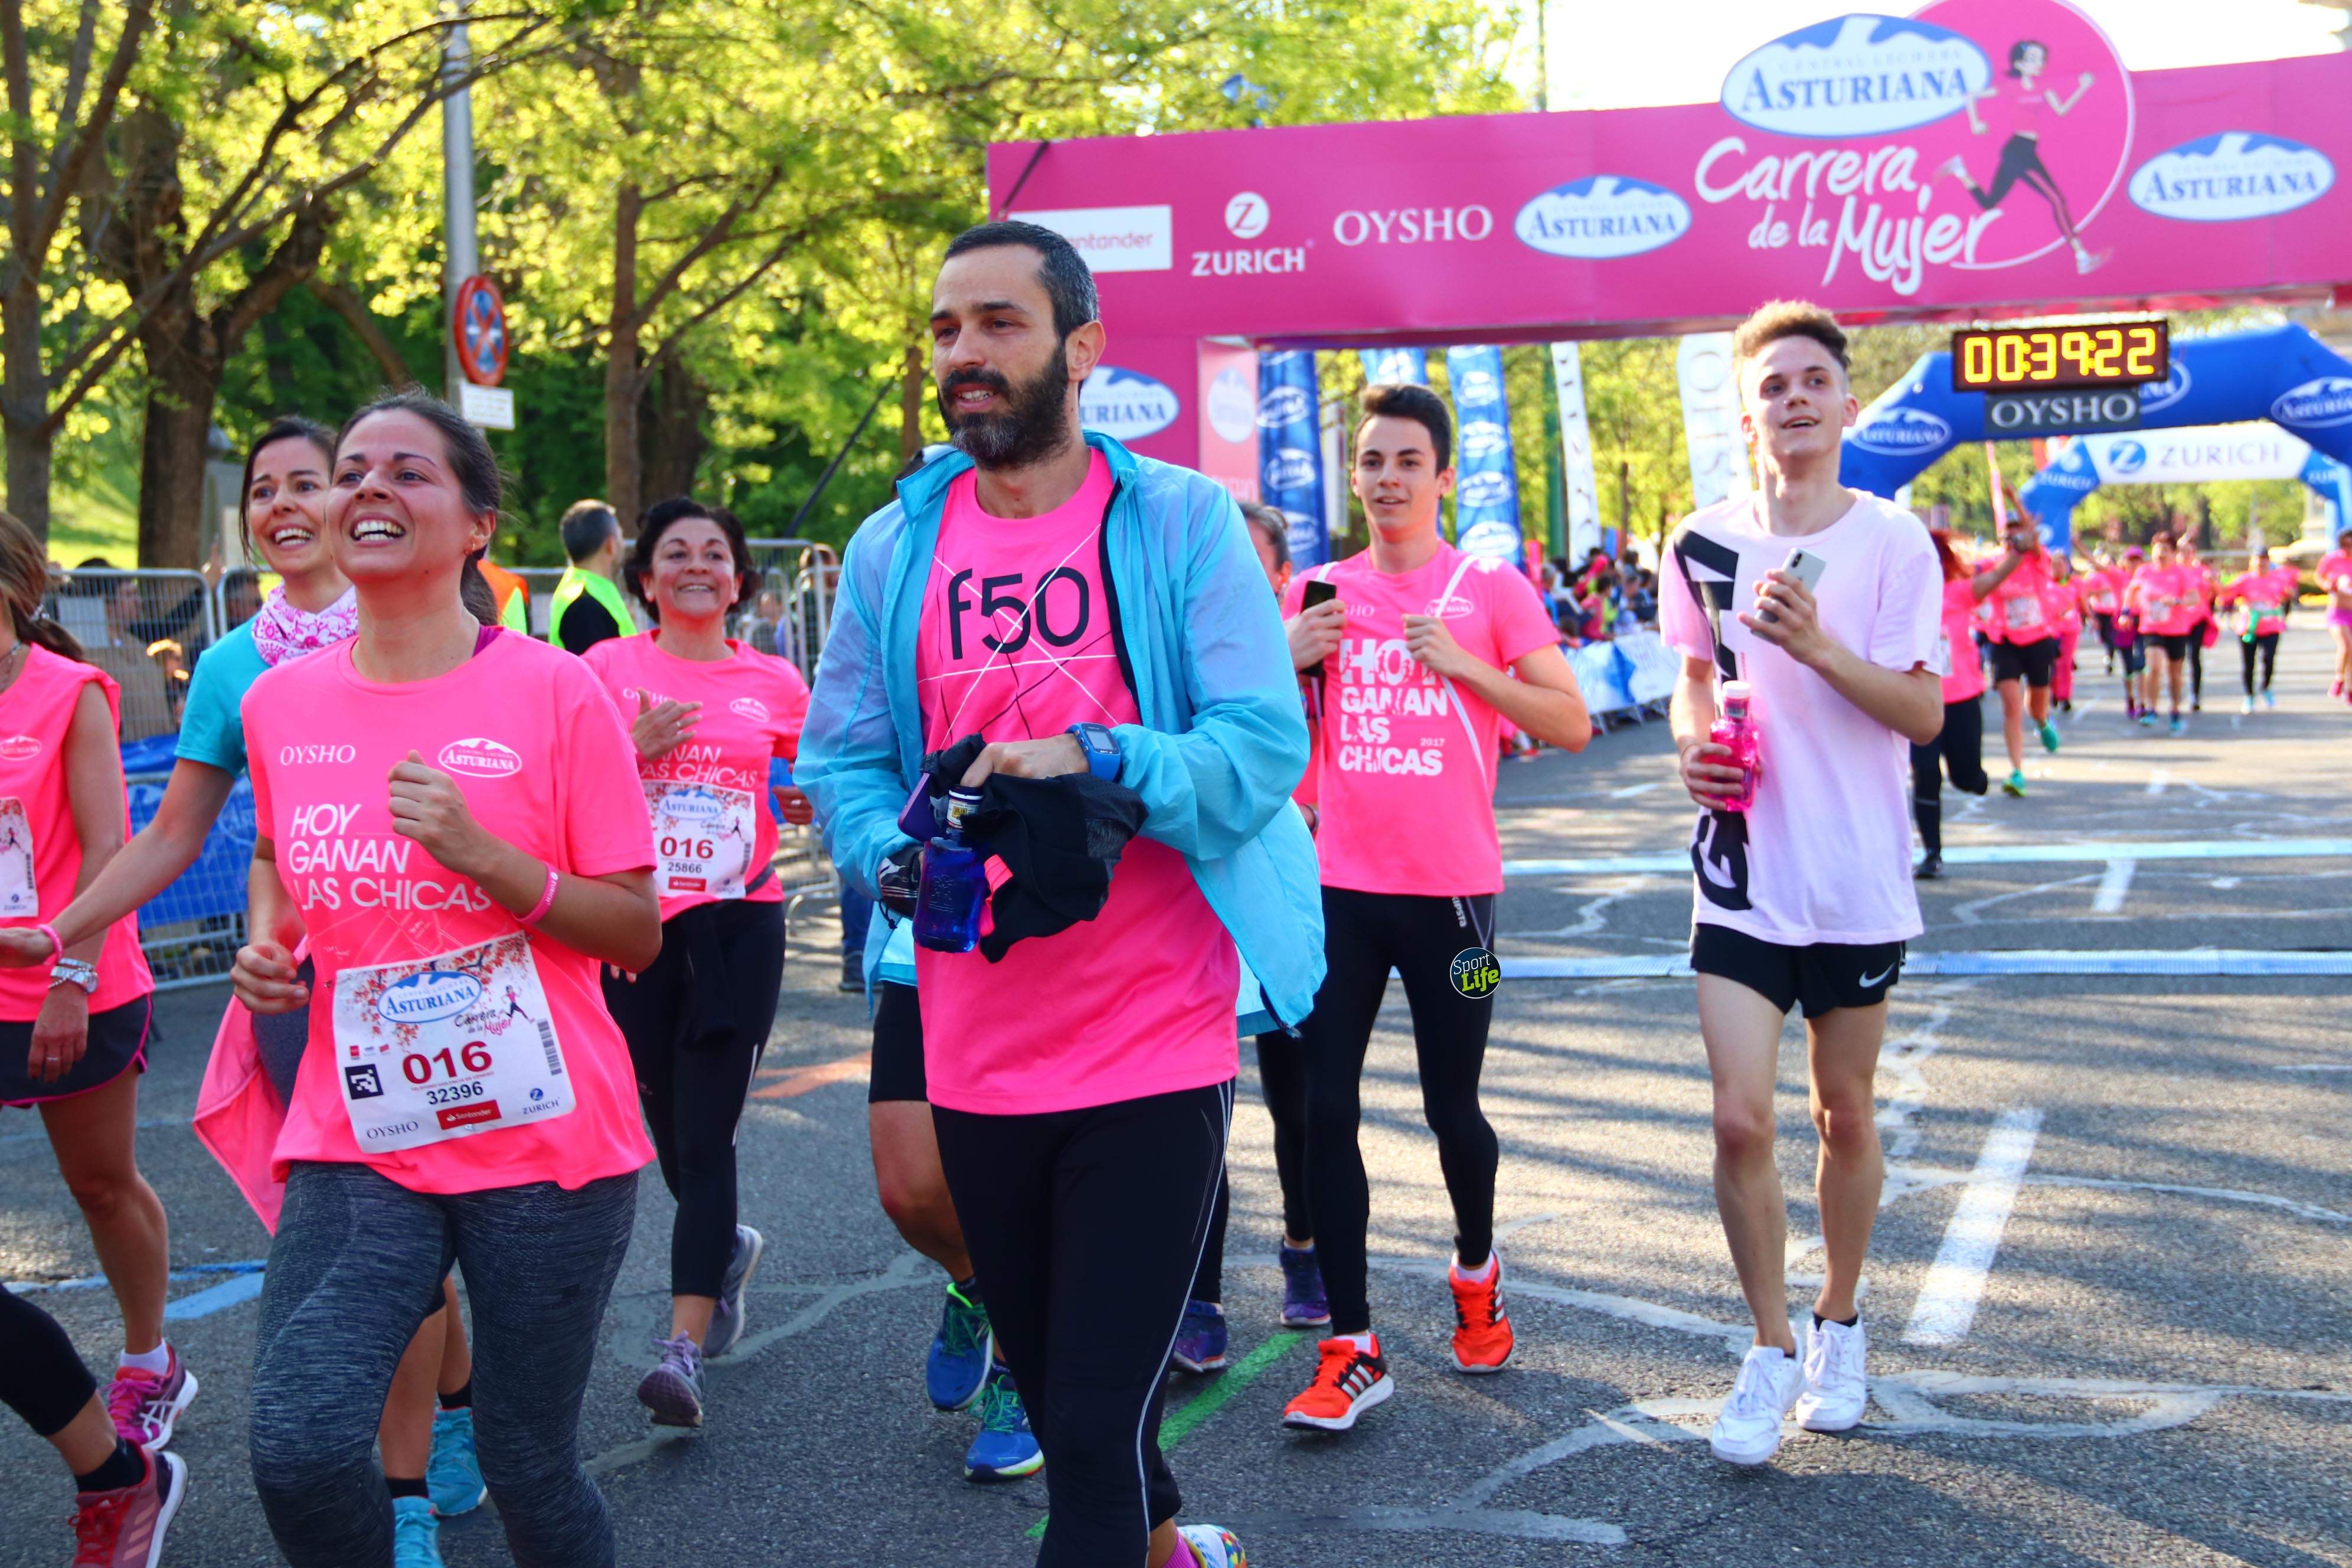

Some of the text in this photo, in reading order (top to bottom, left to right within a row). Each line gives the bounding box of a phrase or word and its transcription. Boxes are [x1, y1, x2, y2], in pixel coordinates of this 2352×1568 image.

[1740, 66, 1971, 112] ASTURIANA
[1695, 136, 1919, 204] Carrera
[2143, 170, 2318, 203] ASTURIANA
[1333, 204, 1493, 246] OYSHO
[1528, 210, 1677, 239] ASTURIANA
[1748, 184, 2004, 296] de la Mujer
[1191, 247, 1305, 276] ZURICH
[1964, 326, 2156, 384] 00:39:22
[1991, 393, 2137, 428] OYSHO
[2158, 442, 2281, 468] ZURICH
[948, 566, 1090, 661] f50
[1340, 686, 1448, 717] GANAN
[1340, 714, 1391, 744] LAS
[1420, 737, 1445, 747] 2017
[280, 744, 356, 766] OYSHO
[444, 749, 515, 770] ASTURIANA
[1338, 745, 1443, 776] CHICAS
[675, 762, 758, 788] CHICAS
[290, 803, 362, 838] HOY
[664, 799, 718, 814] ASTURIANA
[288, 838, 411, 874] GANAN
[660, 837, 714, 859] 016
[668, 861, 703, 874] 25866
[294, 877, 492, 913] LAS CHICAS
[386, 985, 475, 1015] ASTURIANA
[402, 1040, 492, 1085] 016
[426, 1081, 484, 1105] 32396
[522, 1100, 559, 1115] ZURICH
[456, 1108, 492, 1120] Santander
[367, 1121, 419, 1140] OYSHO
